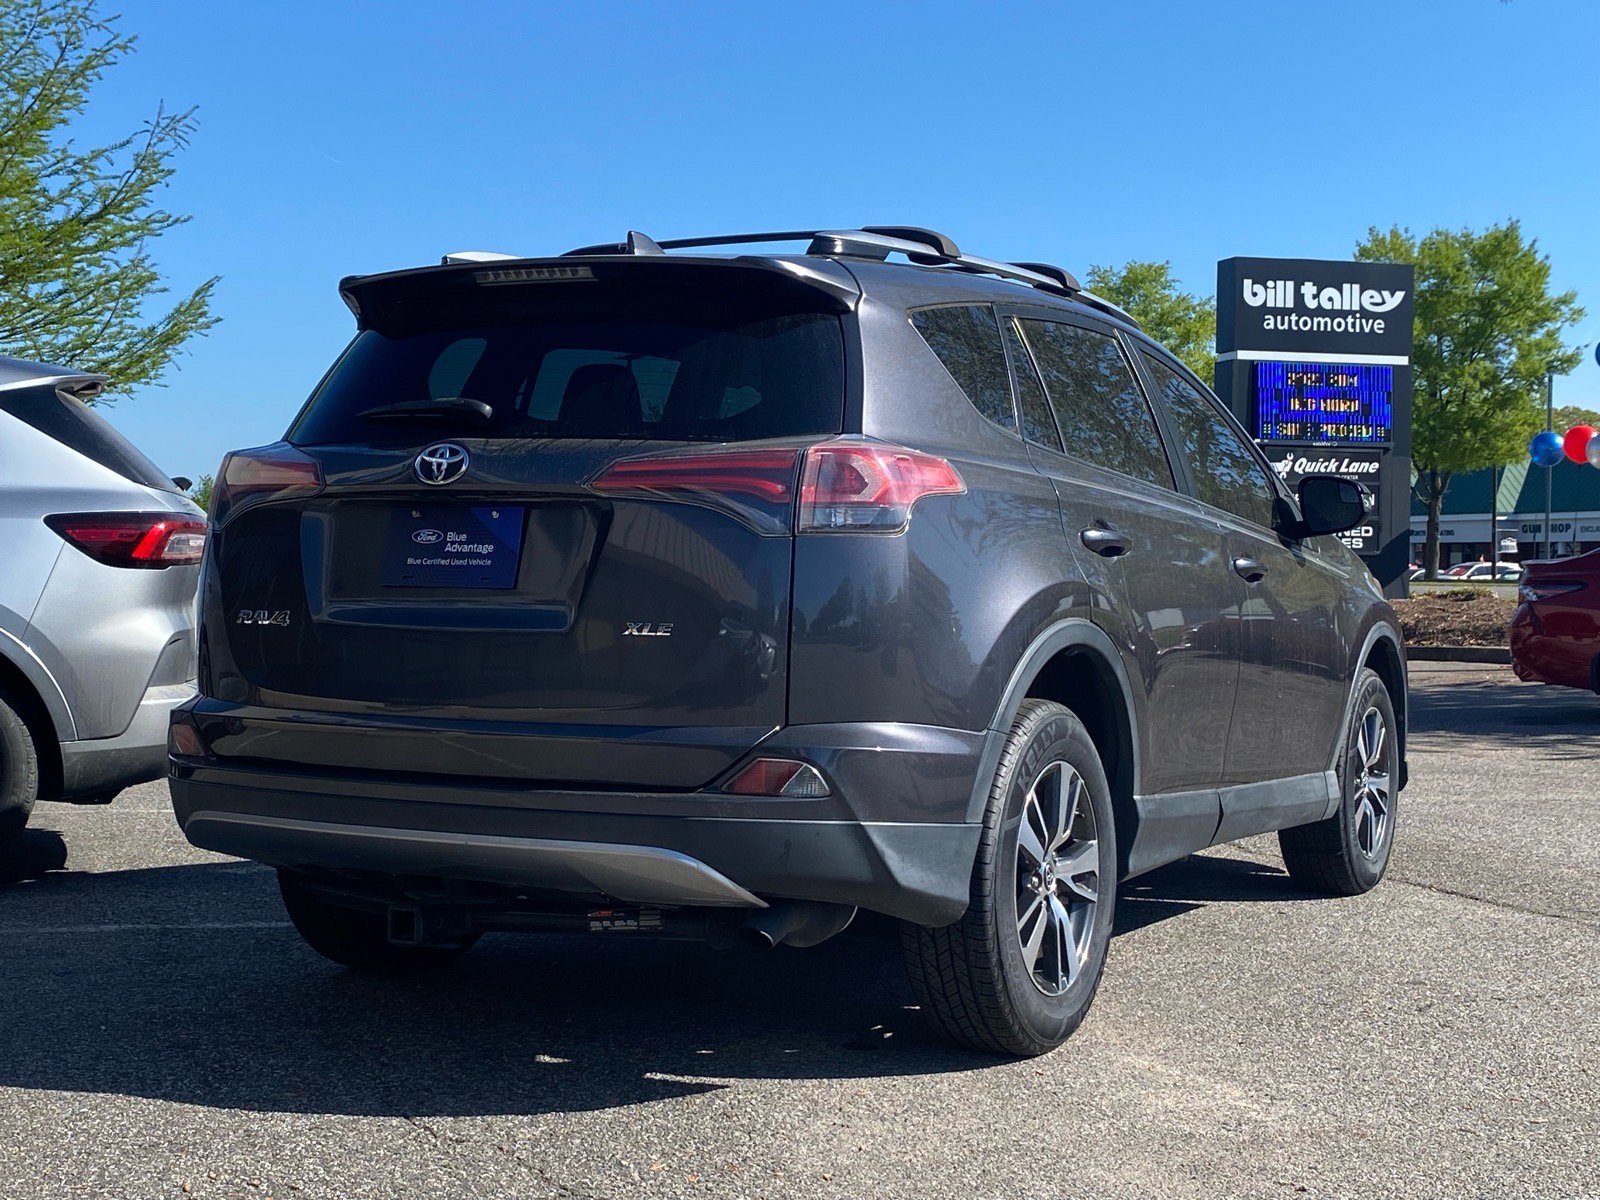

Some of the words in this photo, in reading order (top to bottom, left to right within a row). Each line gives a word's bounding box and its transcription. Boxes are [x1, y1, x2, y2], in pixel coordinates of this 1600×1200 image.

[1243, 279, 1294, 307] bill
[1300, 281, 1406, 313] talley
[1263, 313, 1385, 334] automotive
[1293, 457, 1338, 474] Quick
[1340, 458, 1380, 473] Lane
[1521, 523, 1542, 534] GUN
[1551, 523, 1571, 533] HOP
[416, 531, 439, 541] Ford
[446, 531, 467, 541] Blue
[444, 543, 494, 554] Advantage
[407, 557, 421, 565] Blue
[451, 558, 467, 566] Used
[468, 558, 492, 566] Vehicle
[236, 609, 290, 627] RAV4
[622, 622, 673, 636] XLE
